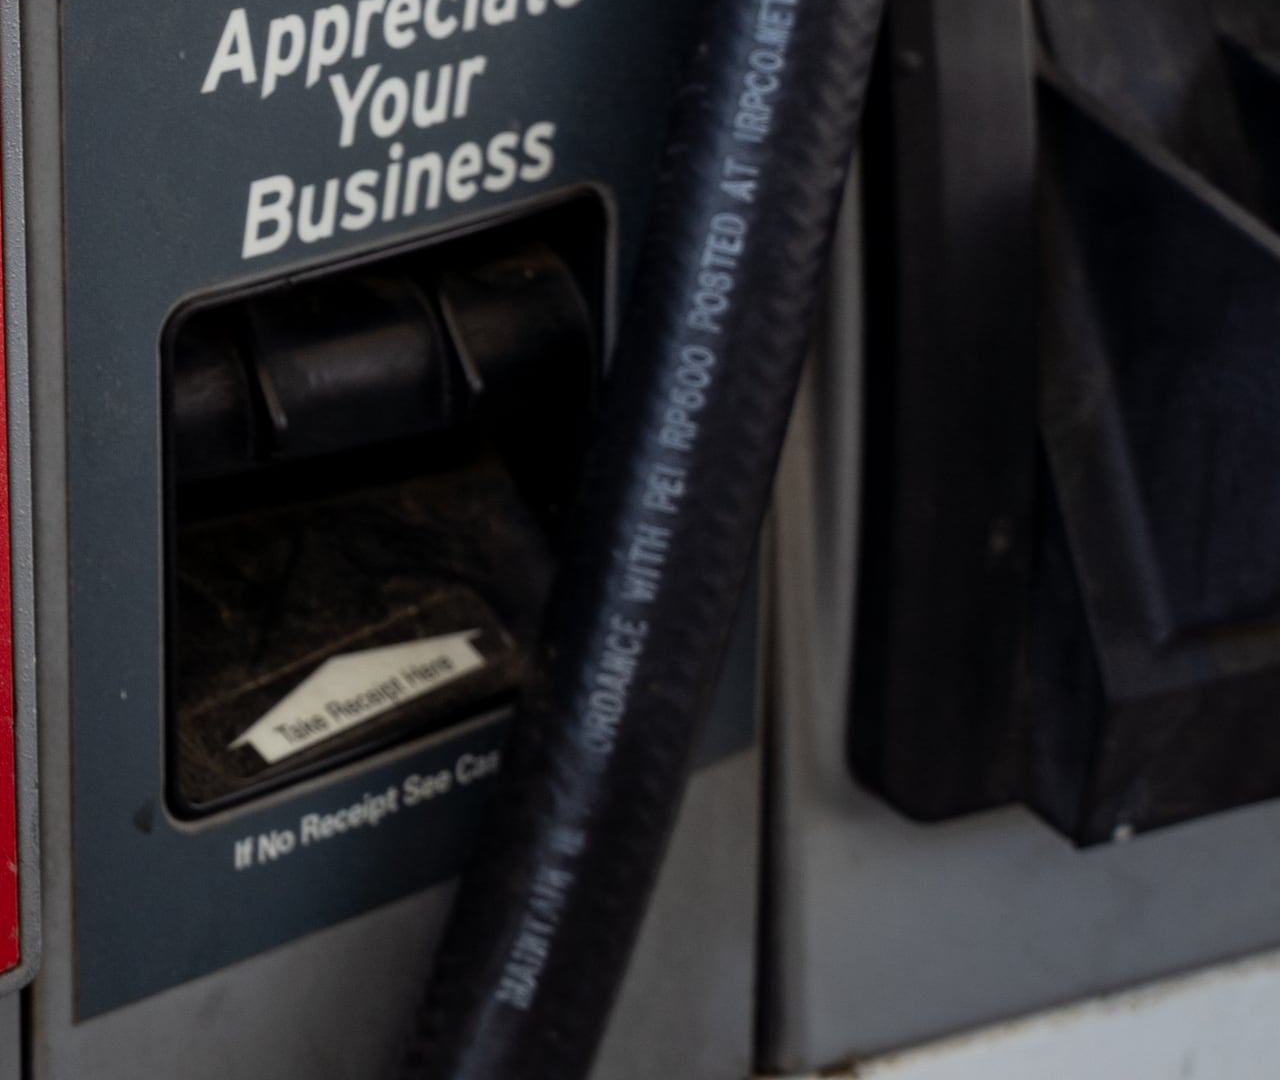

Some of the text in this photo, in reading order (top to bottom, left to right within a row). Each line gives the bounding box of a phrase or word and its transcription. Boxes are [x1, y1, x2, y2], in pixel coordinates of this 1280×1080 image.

[329, 56, 486, 146] Your
[242, 121, 556, 259] Business
[621, 522, 673, 602] WITH
[686, 211, 749, 336] POSTED
[720, 155, 760, 203] AT
[272, 656, 454, 746] Take Receipt Here
[234, 834, 253, 869] If
[258, 828, 295, 863] No
[300, 784, 400, 845] Receipt
[402, 769, 453, 807] See
